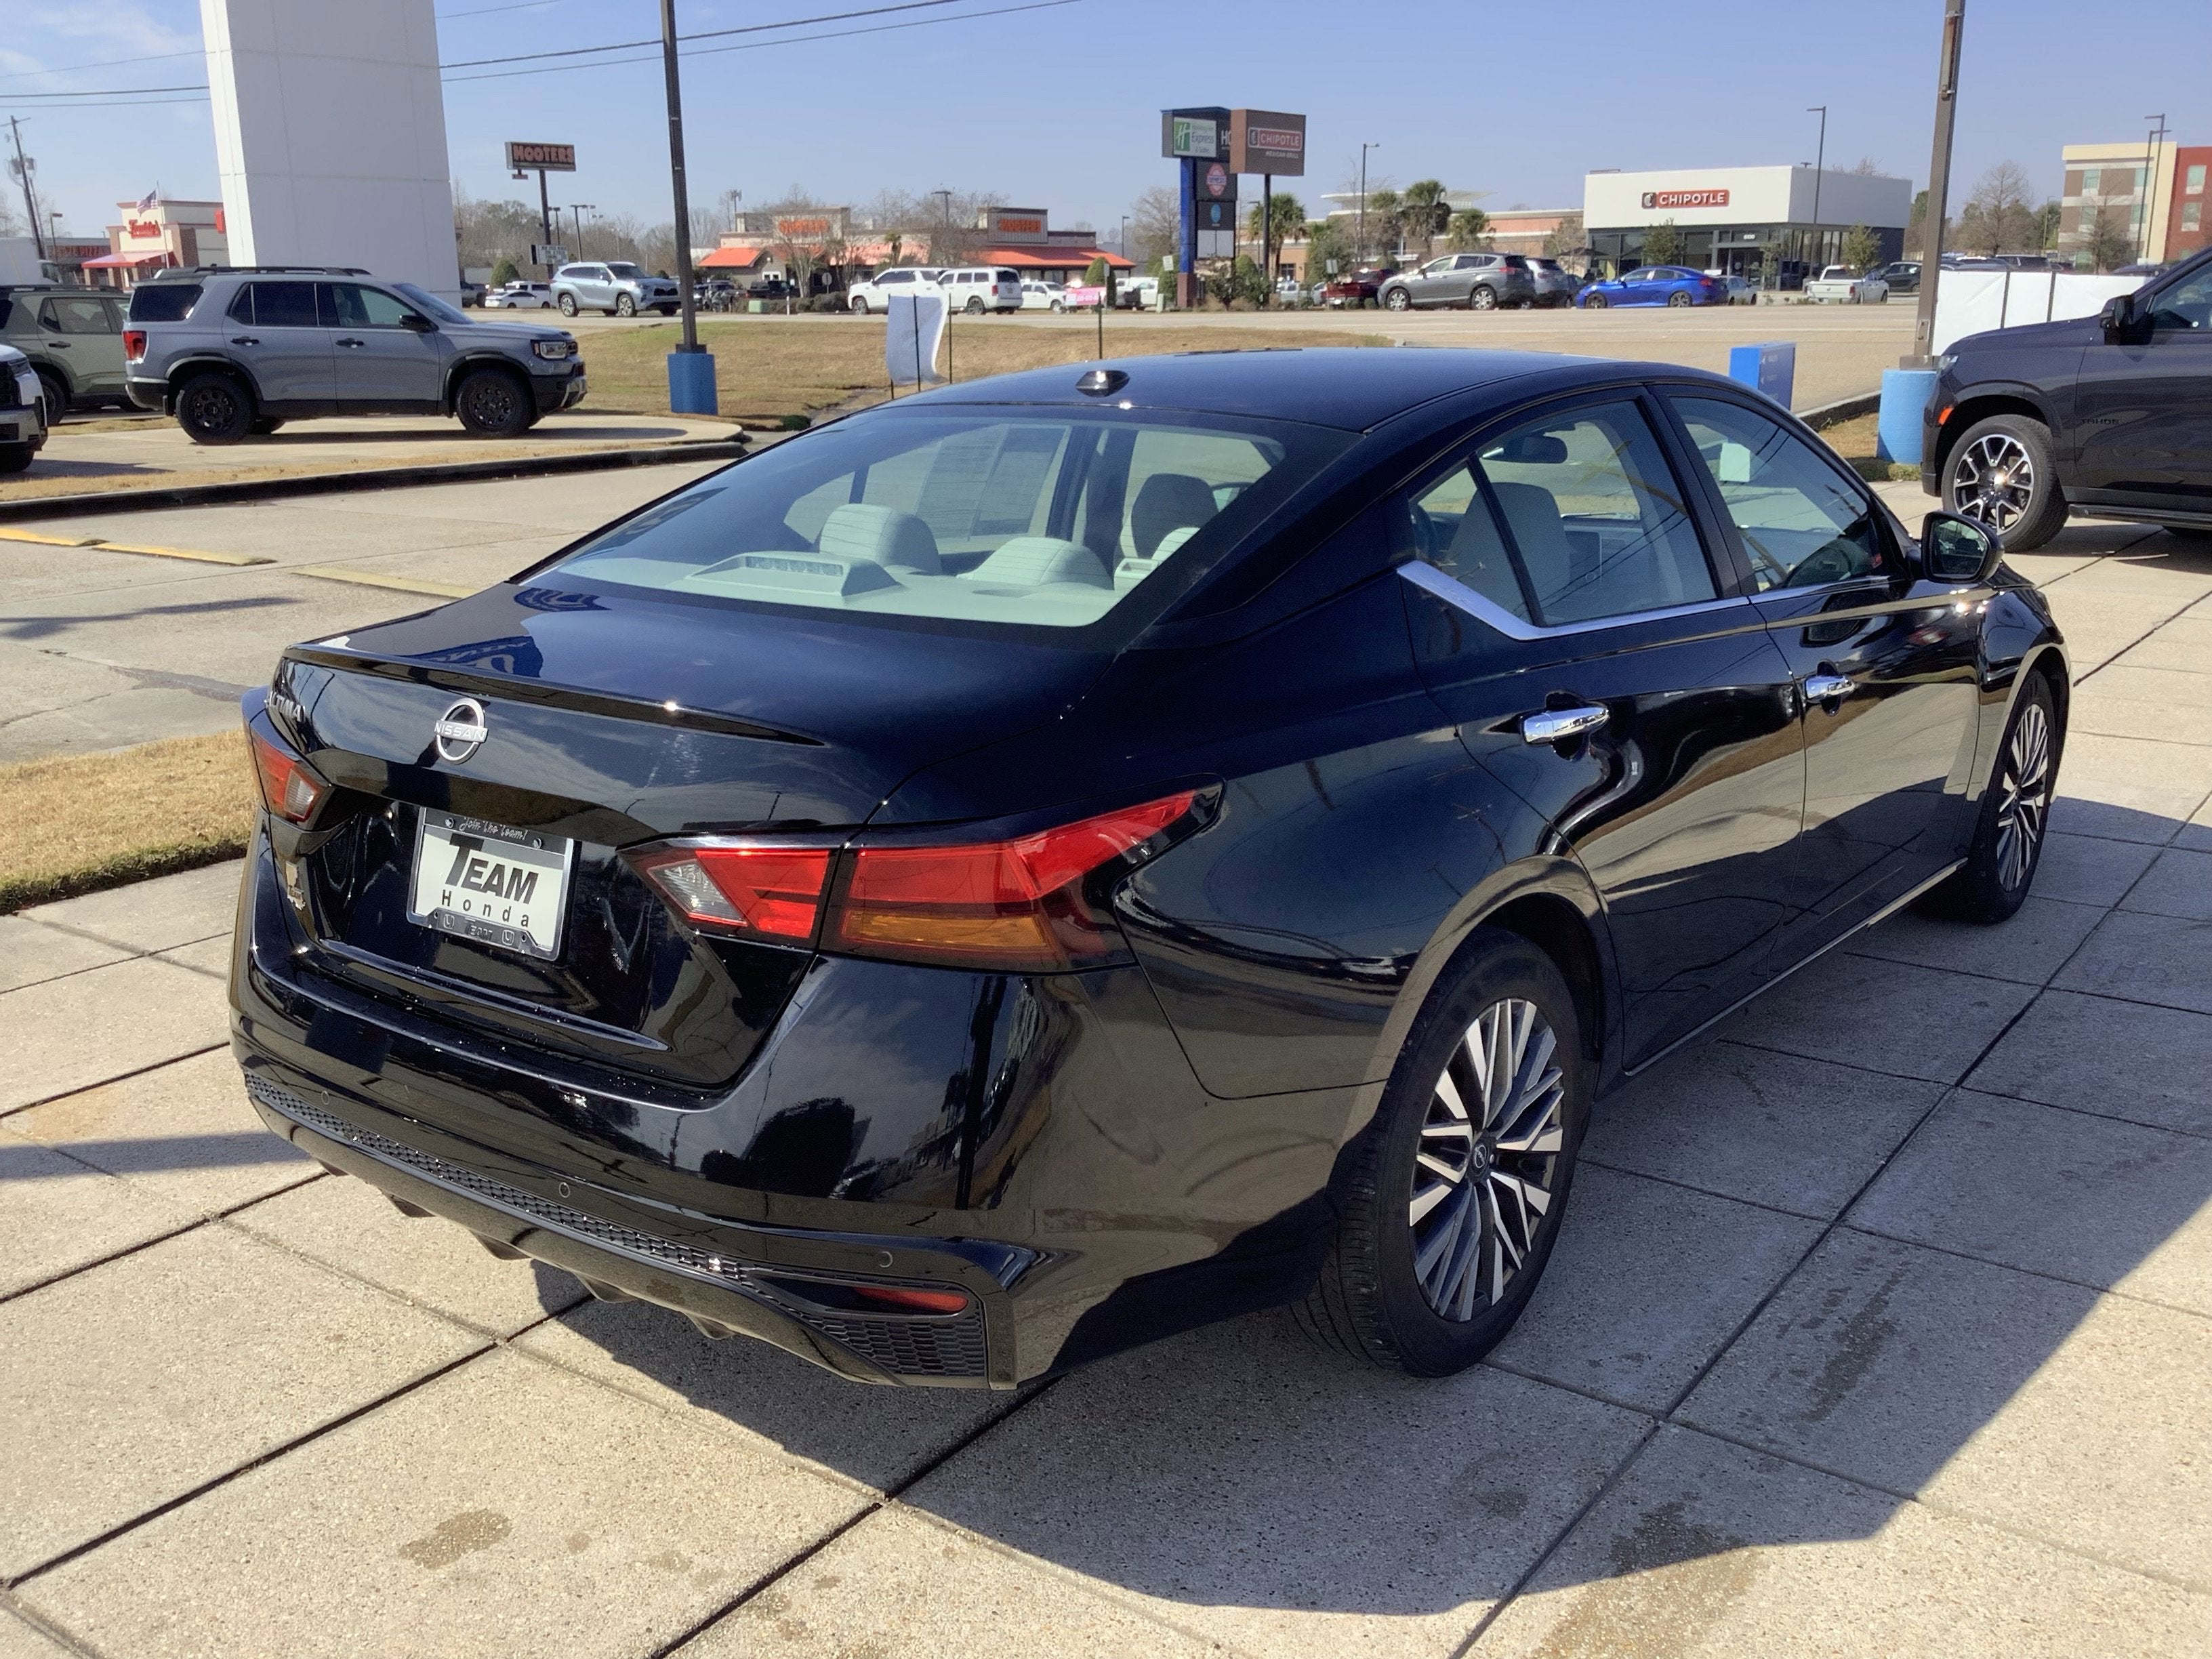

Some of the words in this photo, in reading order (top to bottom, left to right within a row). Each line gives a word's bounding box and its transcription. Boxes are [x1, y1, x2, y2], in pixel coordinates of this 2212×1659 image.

[1261, 133, 1300, 146] CHIPOTLE
[513, 144, 574, 163] HOOTERS
[1660, 192, 1725, 205] CHIPOTLE
[264, 691, 306, 723] ALTIMA
[434, 721, 487, 741] NISSAN
[445, 832, 539, 905] TEAM
[441, 888, 530, 928] Honda
